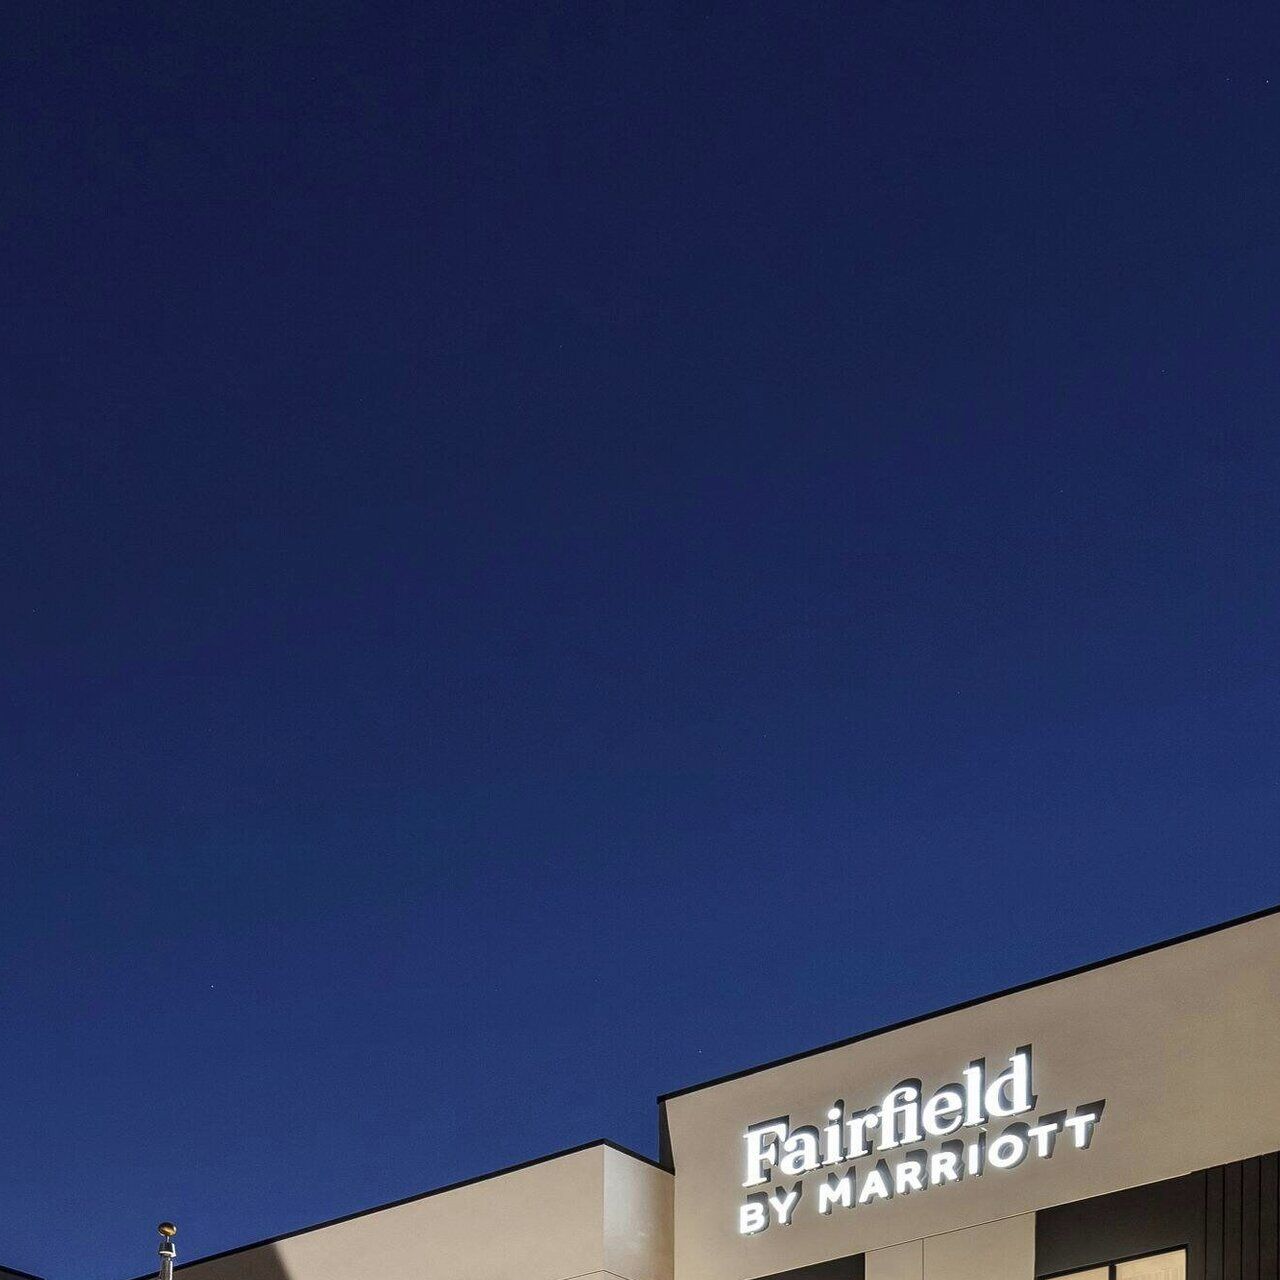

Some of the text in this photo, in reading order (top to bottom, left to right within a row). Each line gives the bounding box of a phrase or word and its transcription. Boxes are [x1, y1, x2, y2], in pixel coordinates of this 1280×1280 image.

[738, 1112, 1097, 1235] BY MARRIOTT
[740, 1051, 1033, 1188] Fairfield
